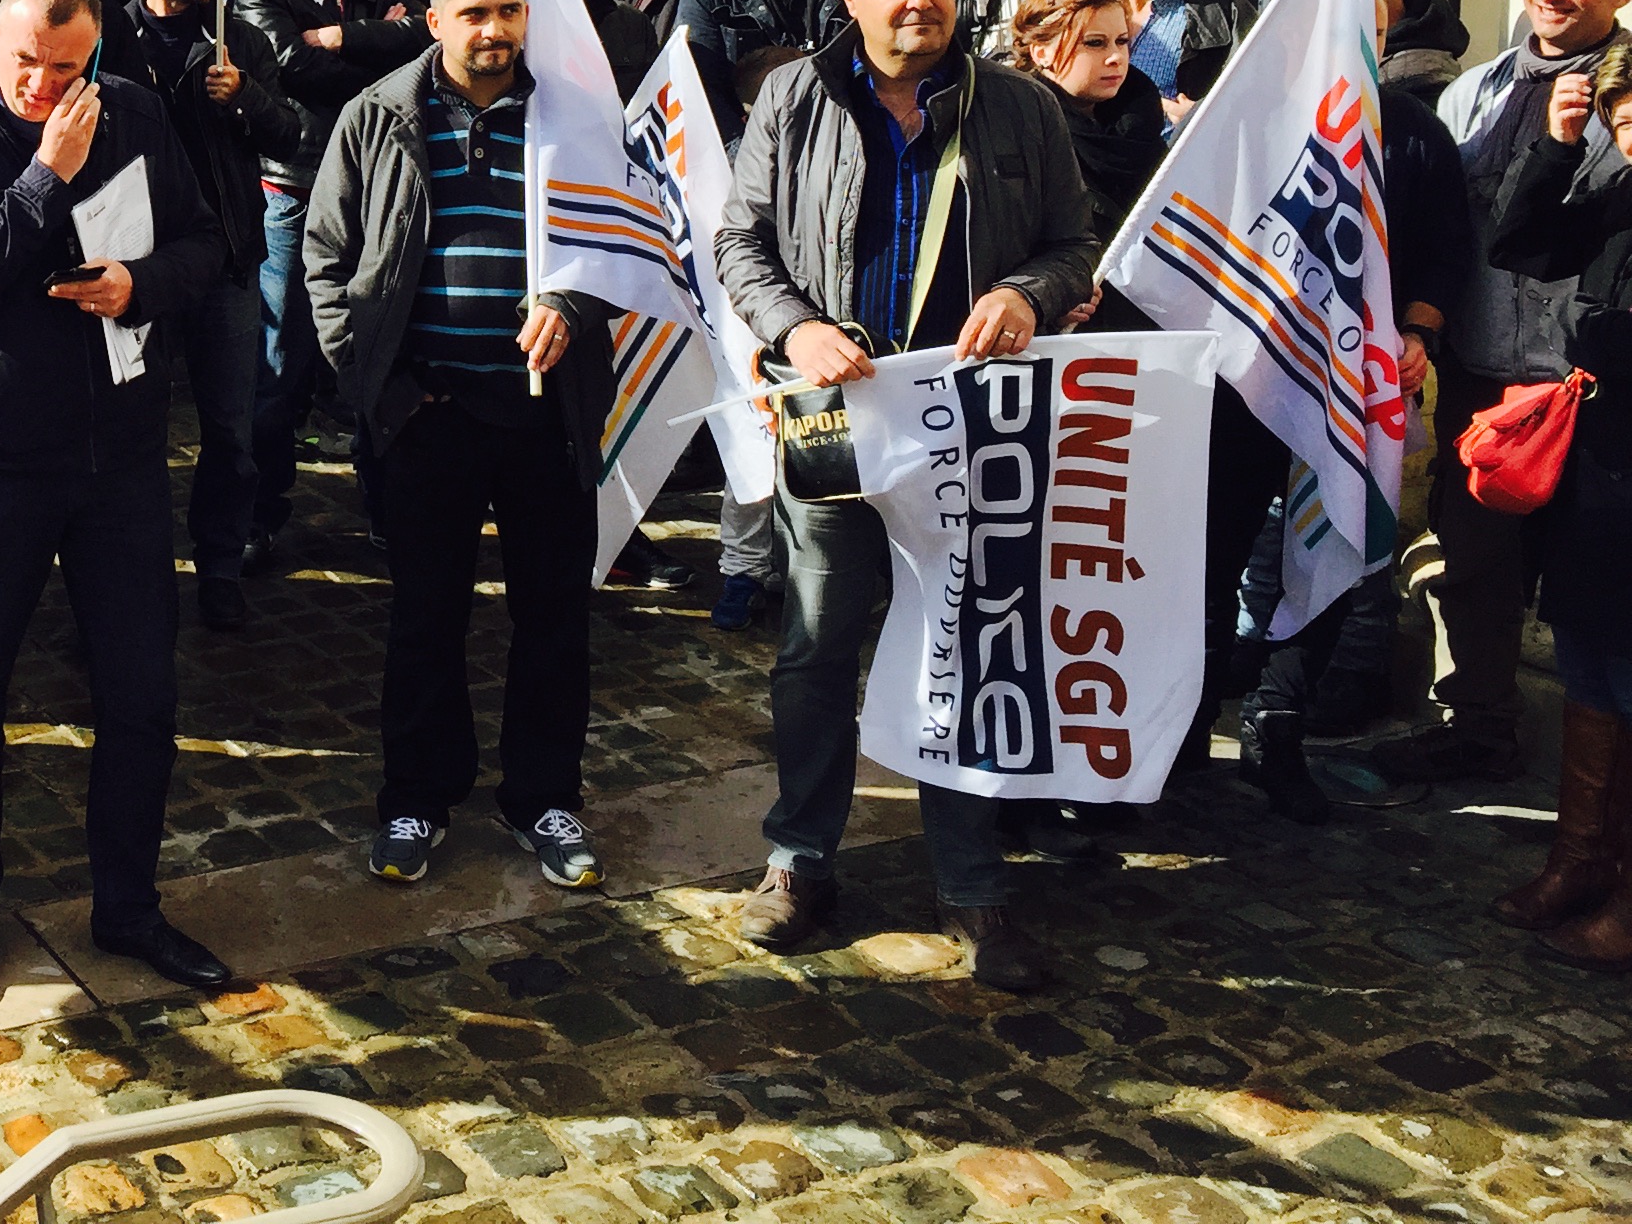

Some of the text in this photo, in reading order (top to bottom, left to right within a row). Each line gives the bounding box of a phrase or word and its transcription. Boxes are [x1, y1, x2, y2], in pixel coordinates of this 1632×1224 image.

[1247, 212, 1336, 316] FORCE
[784, 408, 850, 442] KAPOR
[913, 375, 969, 530] FORCE
[1050, 357, 1147, 780] UNITÉ SGP
